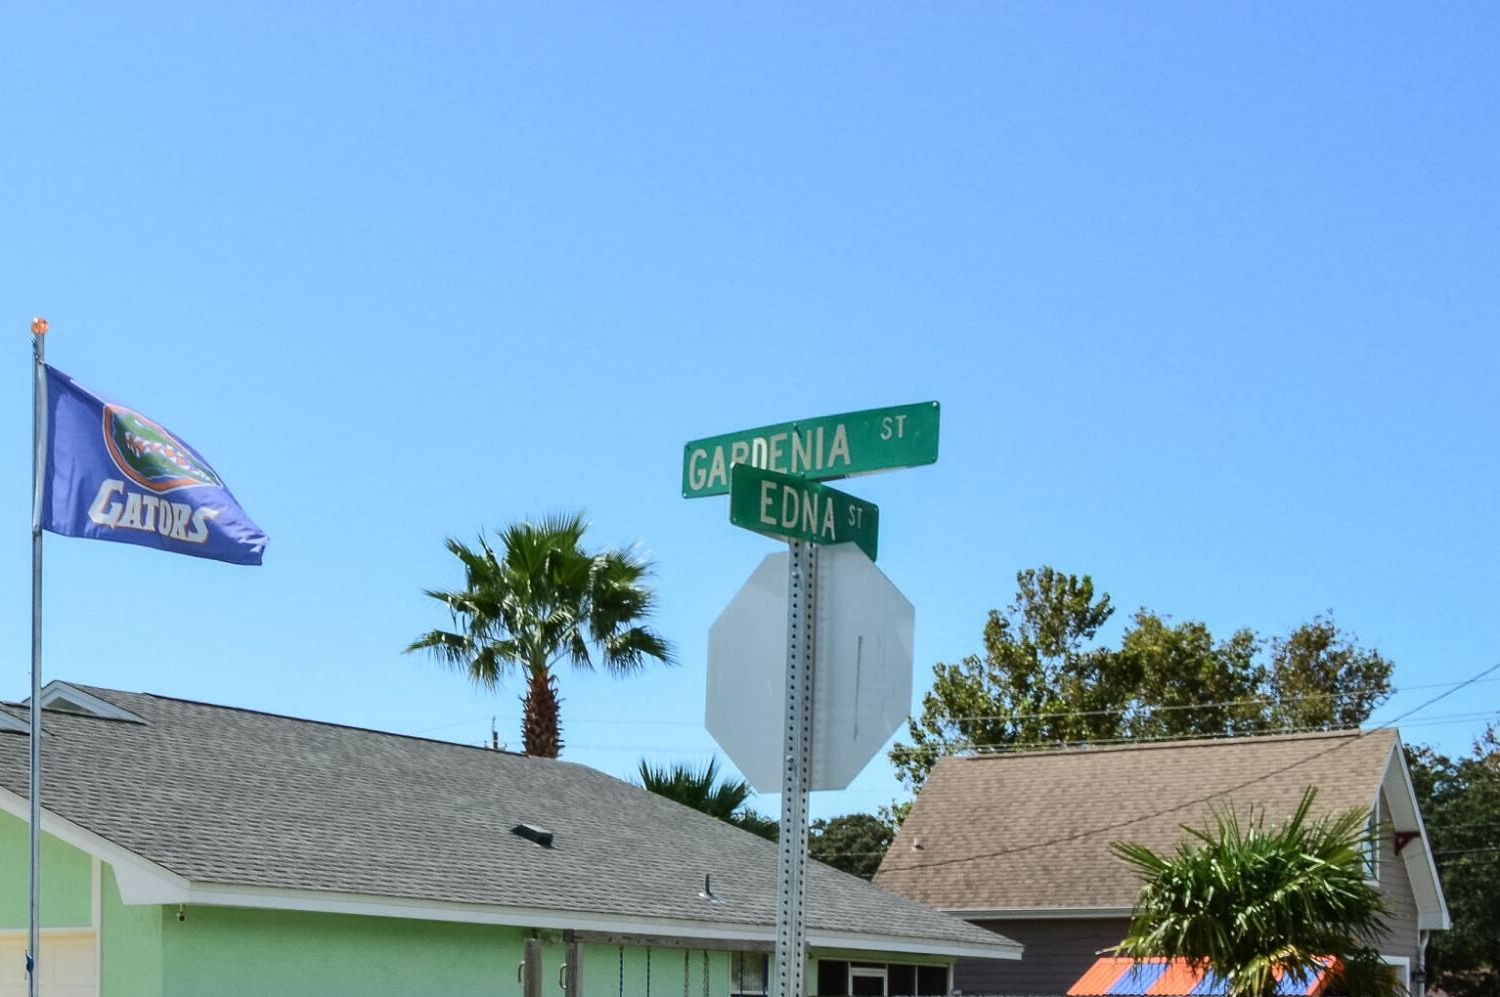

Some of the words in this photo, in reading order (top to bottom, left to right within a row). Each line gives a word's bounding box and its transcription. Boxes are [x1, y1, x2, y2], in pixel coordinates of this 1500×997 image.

[689, 424, 851, 490] GARDENIA
[880, 414, 907, 441] ST
[88, 478, 220, 544] GATORS
[759, 480, 836, 542] EDNA
[848, 504, 863, 529] ST
